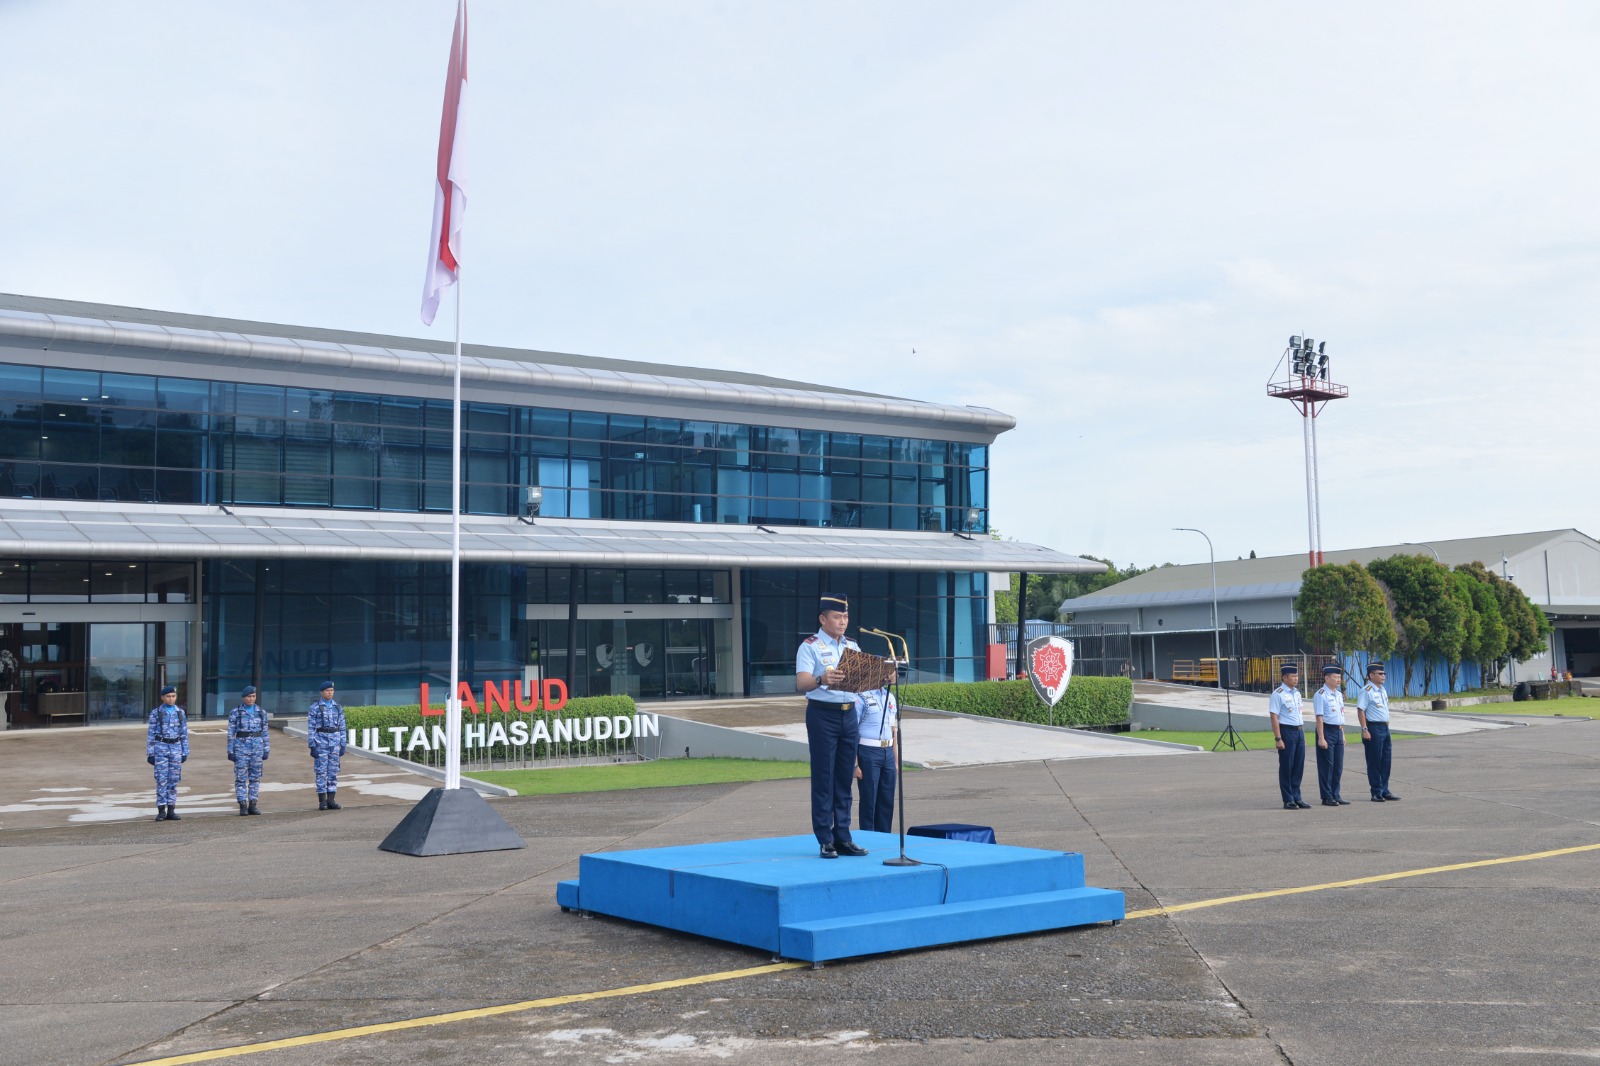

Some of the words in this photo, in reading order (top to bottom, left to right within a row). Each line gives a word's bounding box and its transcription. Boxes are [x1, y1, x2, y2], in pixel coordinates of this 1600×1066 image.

[420, 678, 568, 717] LANUD
[348, 725, 447, 753] ULTAN
[465, 714, 659, 748] HASANUDDIN
